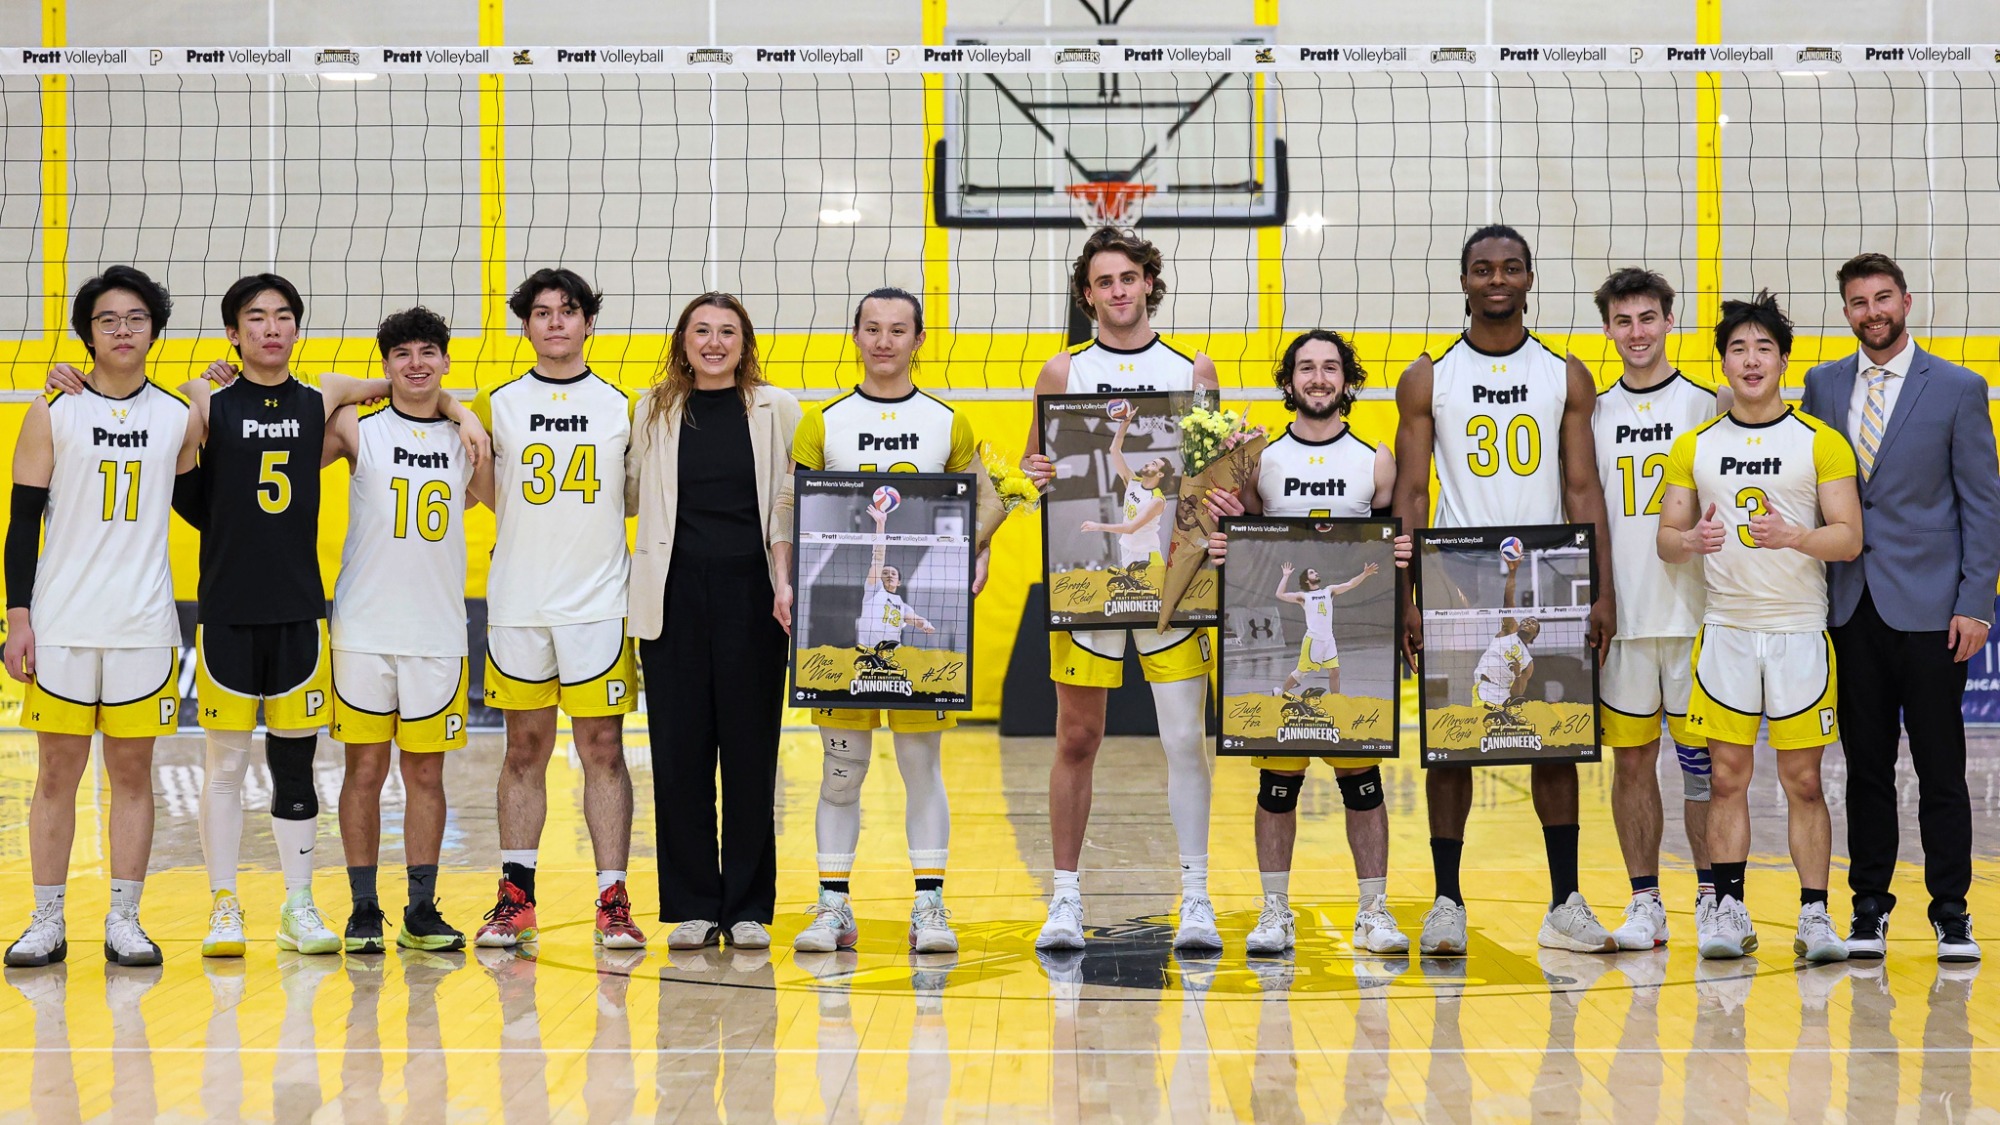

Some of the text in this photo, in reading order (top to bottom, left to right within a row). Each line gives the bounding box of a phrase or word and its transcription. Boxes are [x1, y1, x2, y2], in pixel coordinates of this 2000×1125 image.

[23, 50, 126, 66] Pratt Volleyball
[186, 50, 290, 66] Pratt Volleyball
[315, 52, 360, 65] CANNONEERS
[384, 50, 488, 66] Pratt Volleyball
[557, 49, 663, 65] Pratt Volleyball
[687, 52, 733, 65] CANNONEERS
[757, 48, 863, 64] Pratt Volleyball
[924, 48, 1030, 64] Pratt Volleyball
[1055, 52, 1100, 64] CANNONEERS
[1125, 48, 1231, 64] Pratt Volleyball
[1300, 48, 1406, 64] Pratt Volleyball
[1431, 52, 1476, 64] CANNONEERS
[1500, 48, 1606, 64] Pratt Volleyball
[1667, 48, 1773, 64] Pratt Volleyball
[1797, 50, 1842, 63] CANNONEERS
[1866, 48, 1970, 64] Pratt Volleyball
[1472, 384, 1528, 404] Pratt
[1082, 402, 1108, 411] Volleyball
[242, 419, 300, 438] Pratt
[530, 414, 588, 432] Pratt
[92, 427, 148, 448] Pratt
[858, 433, 919, 450] Pratt
[1616, 423, 1673, 444] Pratt
[1466, 414, 1541, 477] 30
[394, 447, 449, 469] Pratt
[1720, 456, 1782, 475] Pratt
[257, 450, 292, 514] 5
[522, 443, 601, 505] 34
[98, 460, 142, 522] 11
[957, 483, 967, 495] P
[1284, 478, 1346, 496] Pratt
[1617, 452, 1668, 516] 12
[390, 476, 451, 542] 16
[1736, 486, 1769, 548] 3
[1382, 528, 1392, 539] P
[1575, 533, 1585, 544] P
[1067, 589, 1097, 607] Reid
[882, 604, 901, 627] 13
[1197, 632, 1211, 662] P
[808, 664, 843, 683] Wang
[921, 661, 963, 683] #13
[606, 679, 626, 706] P
[850, 680, 913, 697] CANNONEERS
[159, 697, 176, 725] P
[306, 689, 324, 717] P
[1229, 702, 1262, 719] Jude
[445, 713, 463, 740] P
[1351, 709, 1379, 730] #4
[1549, 712, 1591, 737] #30
[1818, 707, 1834, 736] P
[1277, 727, 1340, 744] CANNONEERS
[1443, 725, 1472, 743] Regis
[1480, 735, 1542, 753] CANNONEERS
